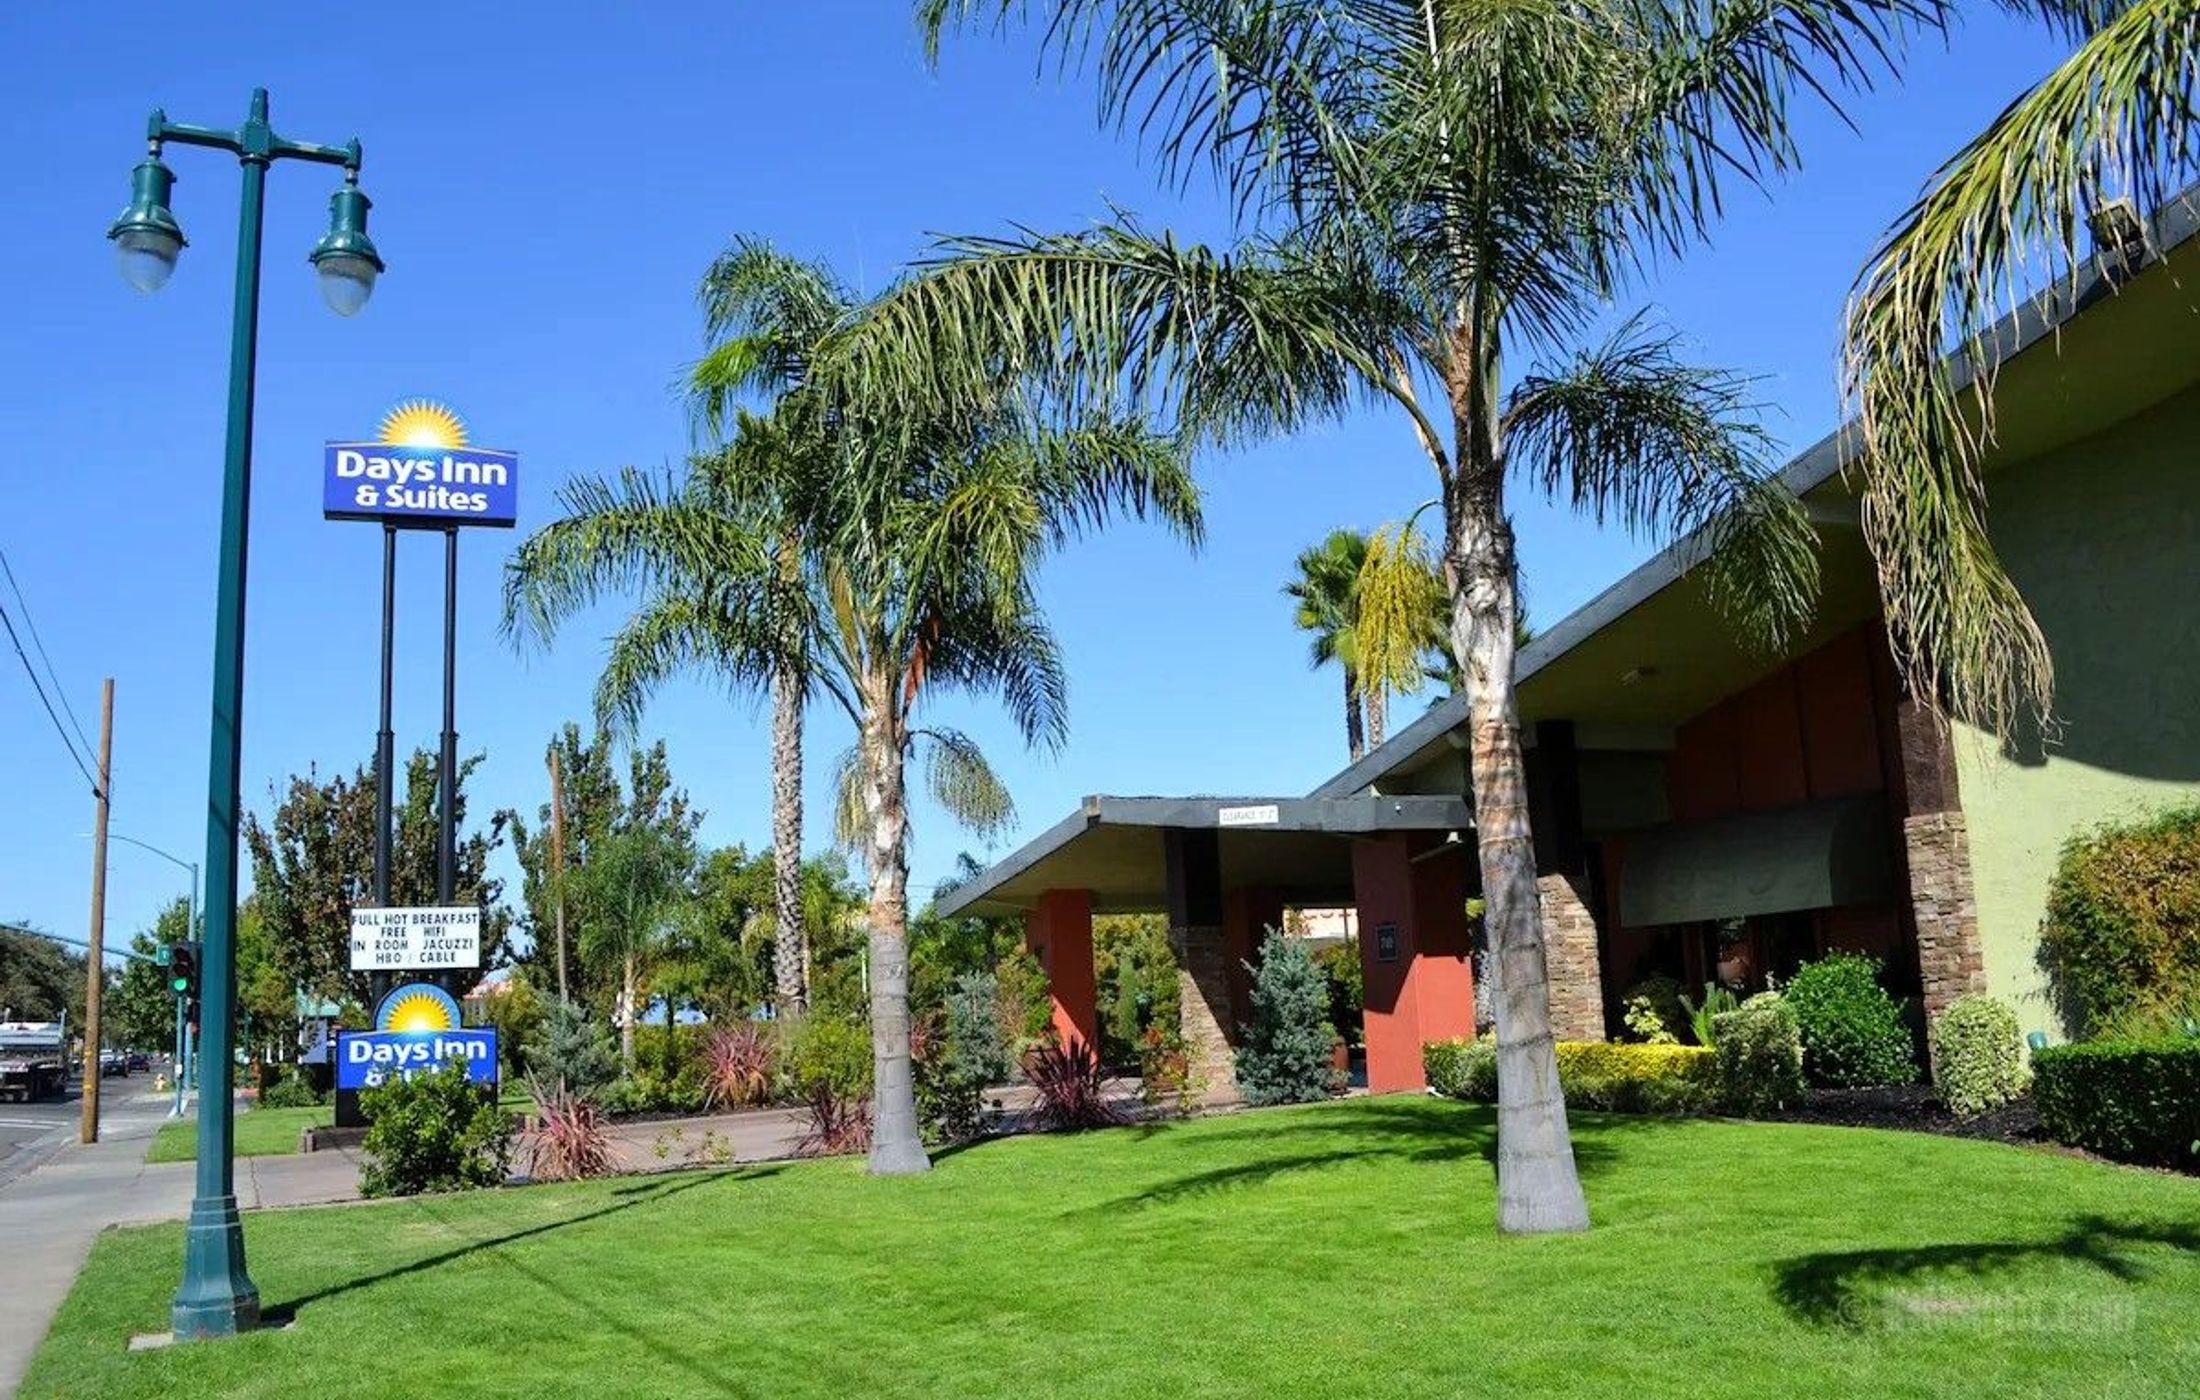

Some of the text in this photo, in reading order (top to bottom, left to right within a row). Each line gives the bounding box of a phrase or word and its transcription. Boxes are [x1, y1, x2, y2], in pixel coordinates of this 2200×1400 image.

[336, 450, 508, 486] Days Inn
[355, 484, 488, 512] & Suites
[351, 912, 478, 926] FULL HOT BREAKFAST
[381, 926, 407, 937] FREE
[353, 938, 473, 951] IN ROOM JACUZZI
[375, 951, 456, 964] HBO CABLE
[349, 1039, 430, 1065] Days
